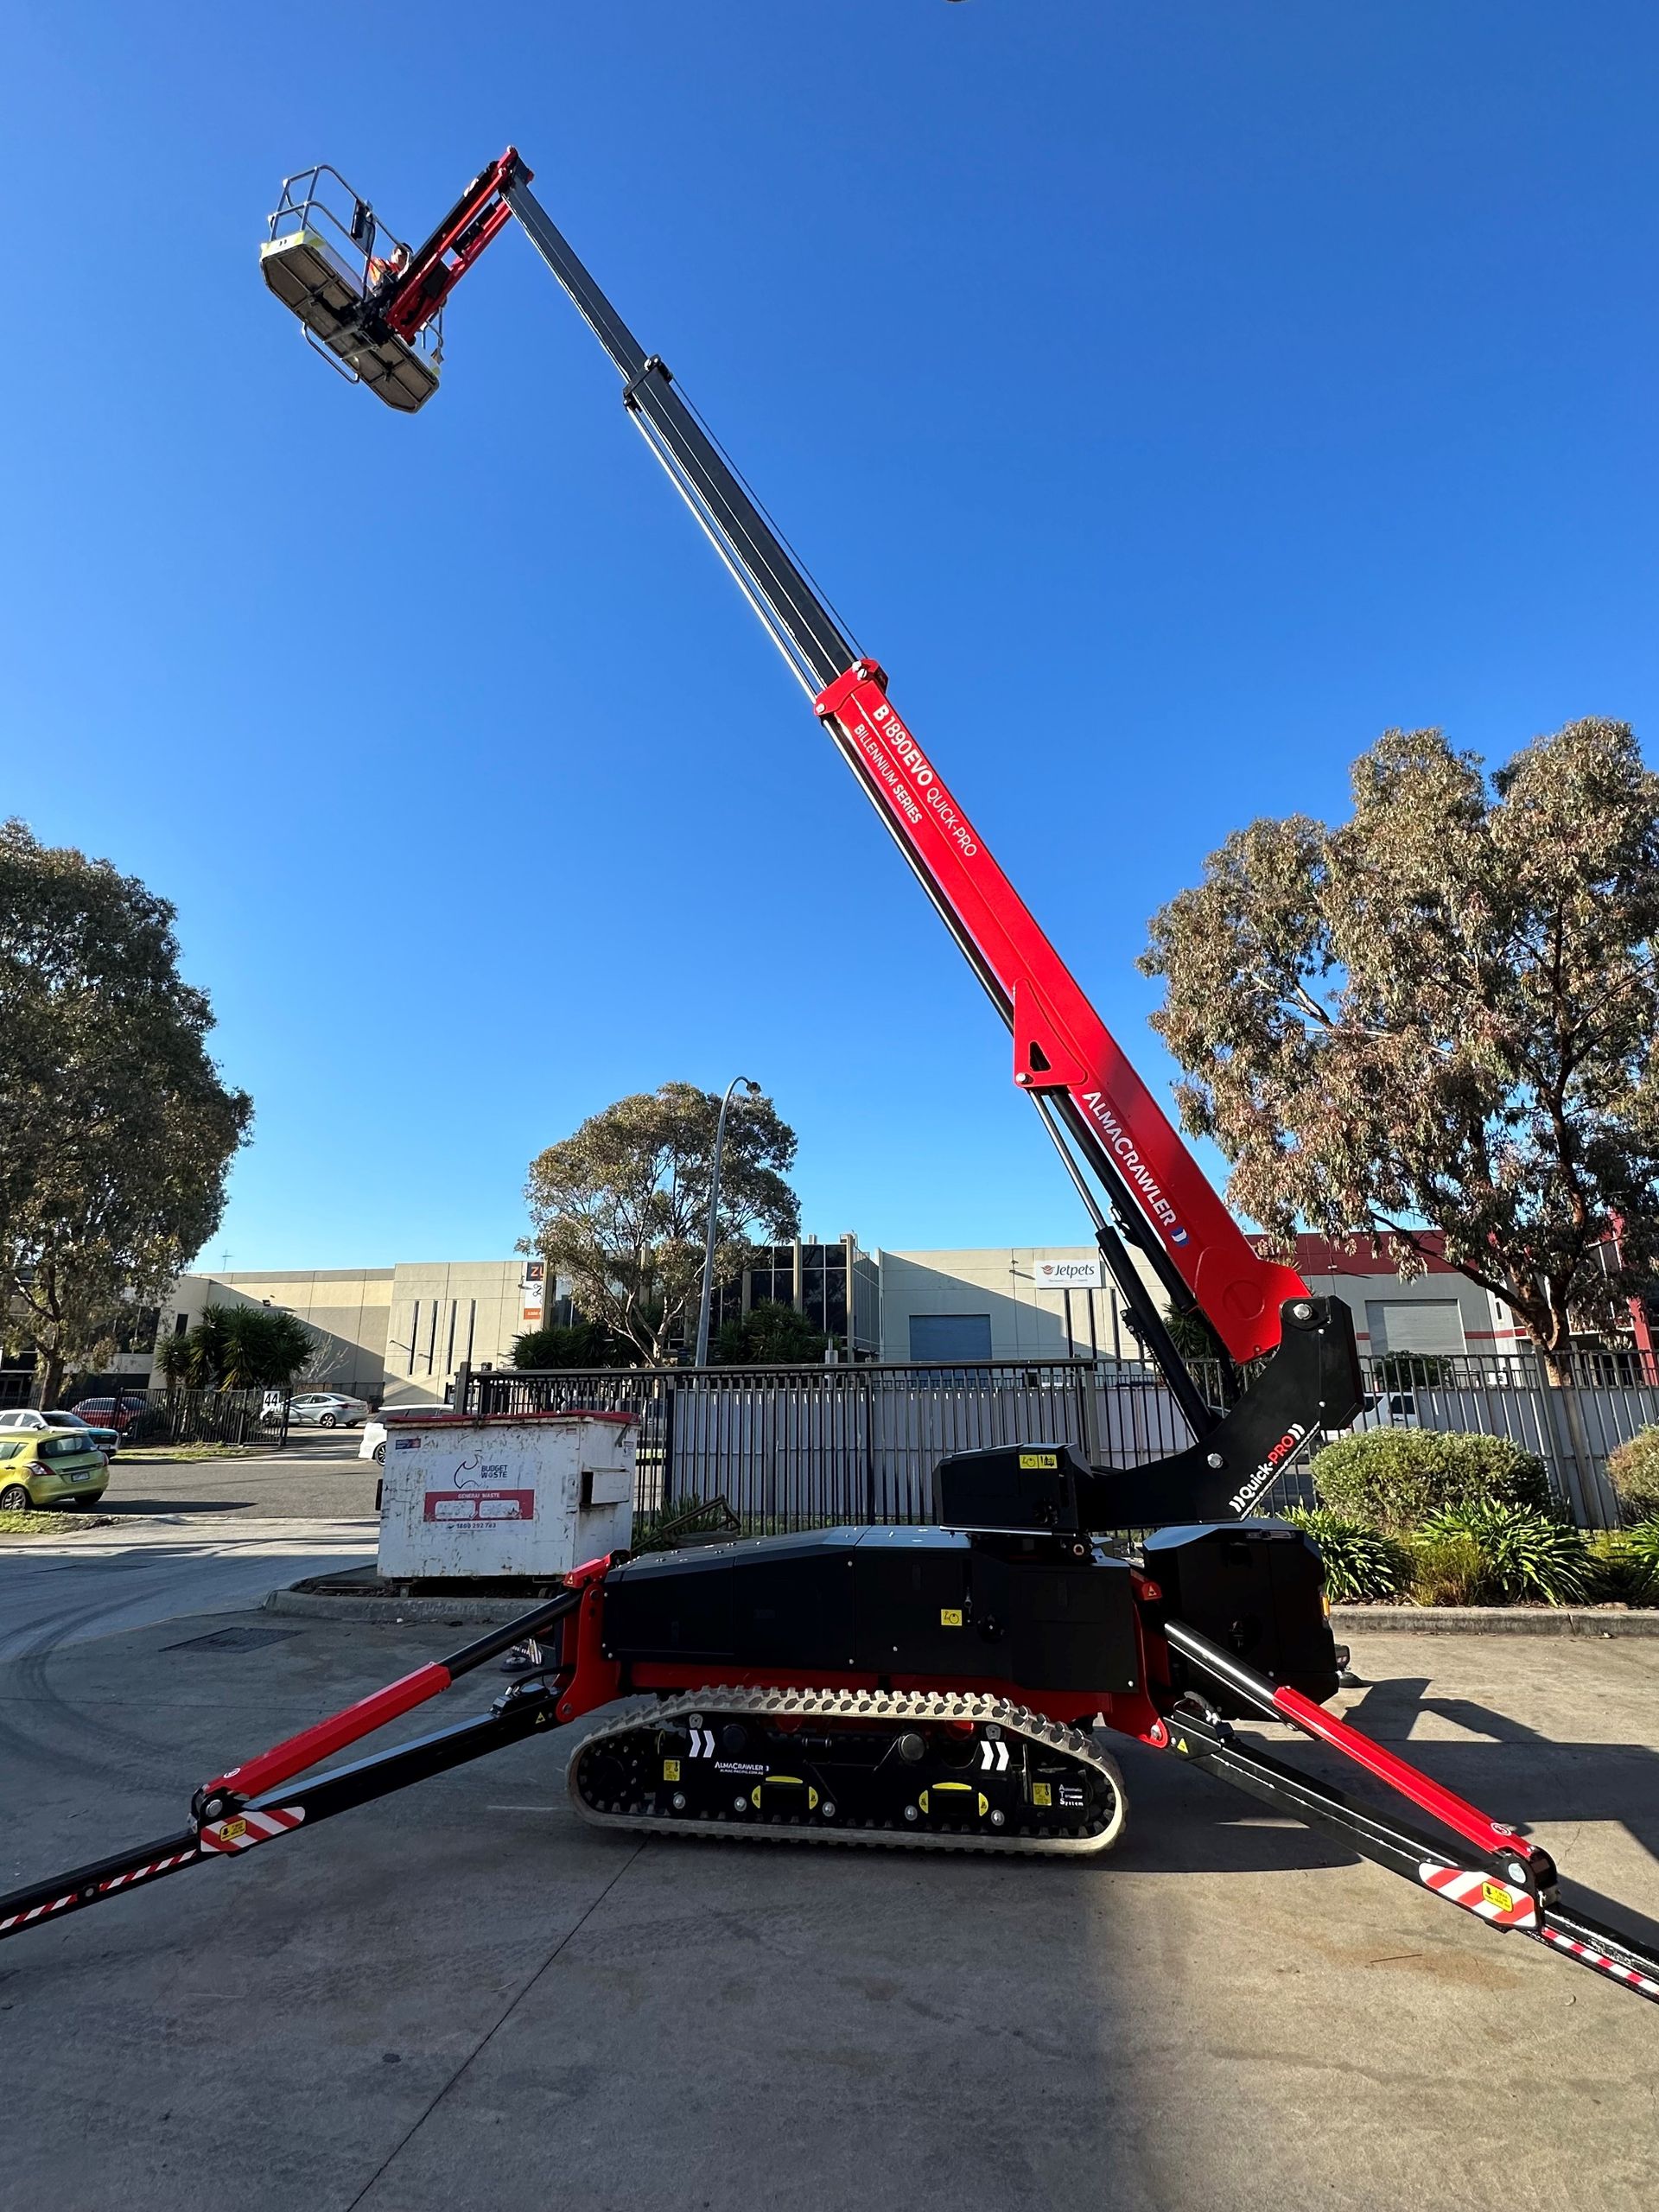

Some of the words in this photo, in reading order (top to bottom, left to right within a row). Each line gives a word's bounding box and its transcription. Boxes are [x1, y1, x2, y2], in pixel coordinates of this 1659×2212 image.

[854, 723, 897, 787] BILLENNIUM
[893, 784, 923, 824] SERIES
[926, 786, 977, 857] QUICK-PRO
[1054, 1264, 1095, 1279] Jetpets
[264, 1393, 278, 1407] 44
